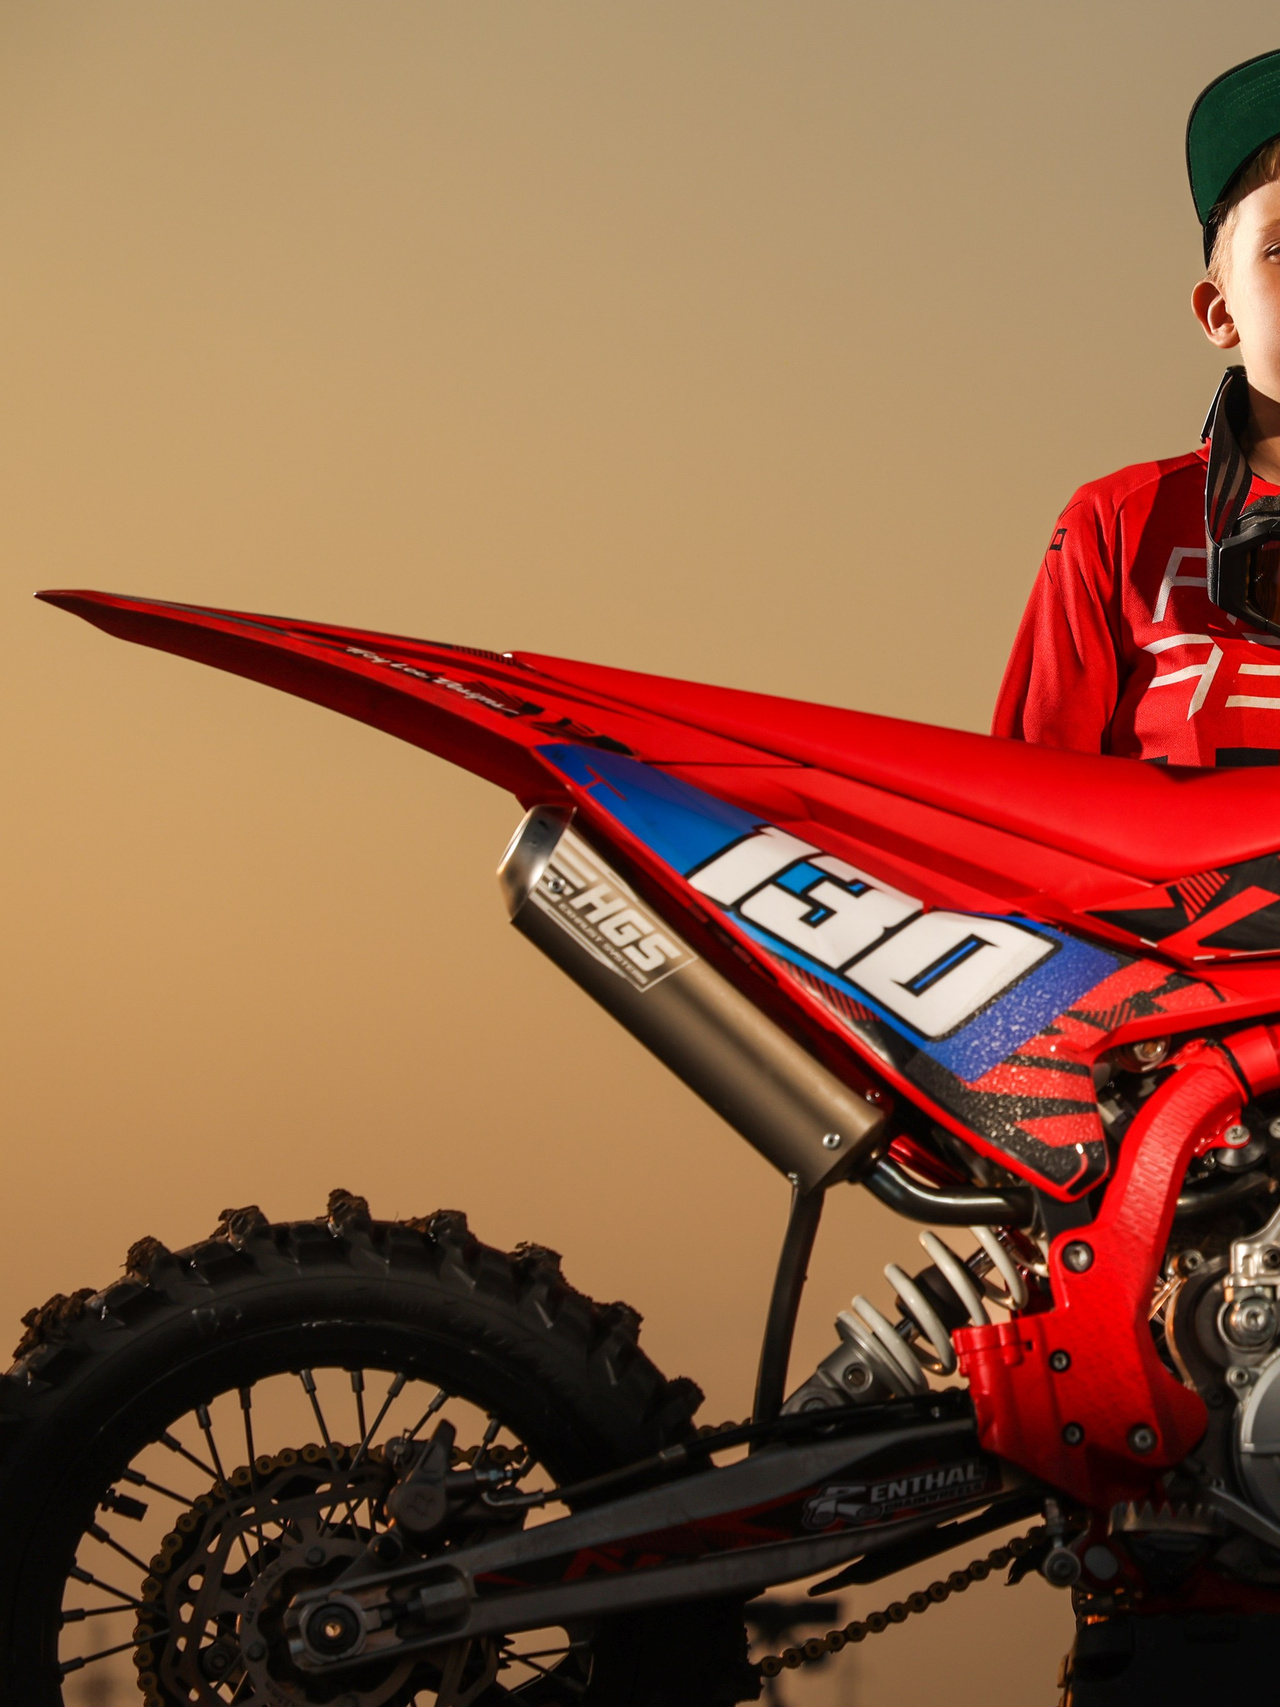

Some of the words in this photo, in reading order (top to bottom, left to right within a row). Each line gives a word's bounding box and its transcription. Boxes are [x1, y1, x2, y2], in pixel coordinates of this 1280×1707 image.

[557, 903, 604, 944] EXHAUST
[601, 937, 649, 985] SYSTEMS
[568, 882, 682, 972] HGS
[686, 825, 1058, 1040] 130
